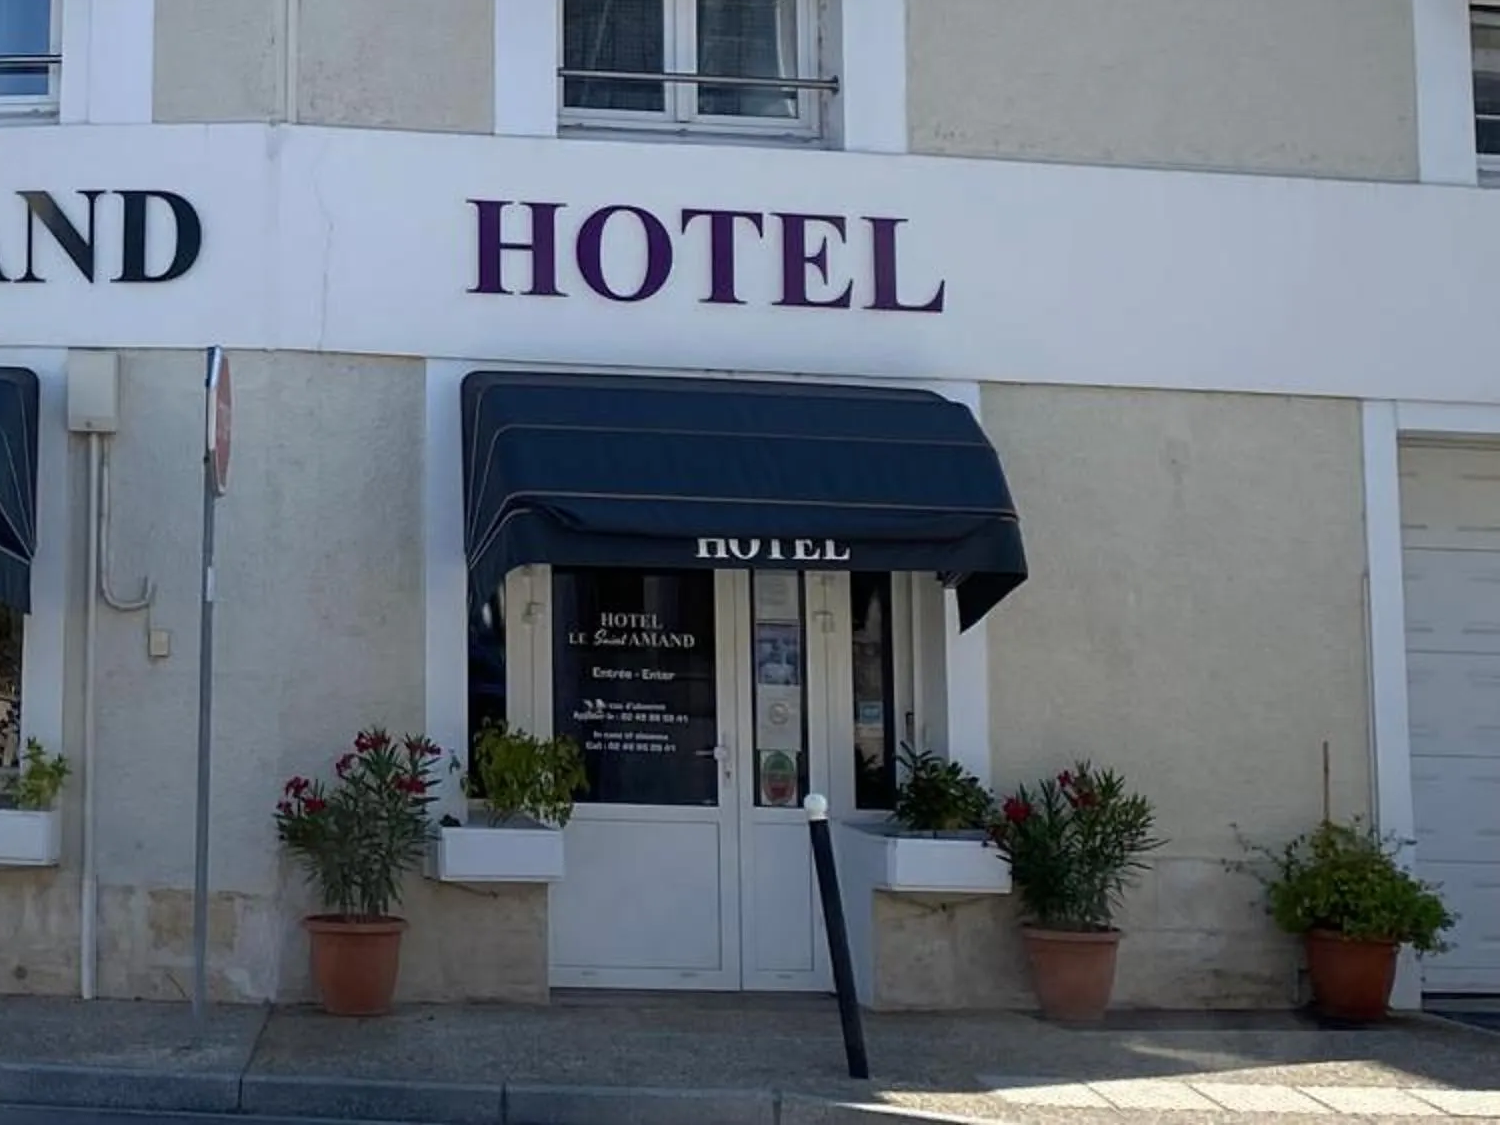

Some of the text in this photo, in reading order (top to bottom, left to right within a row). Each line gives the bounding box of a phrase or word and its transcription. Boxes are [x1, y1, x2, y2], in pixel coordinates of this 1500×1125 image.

[466, 198, 946, 313] HOTEL
[695, 538, 851, 560] HOTEL
[600, 612, 664, 630] HOTEL
[568, 628, 696, 648] LE Saint AMAND
[641, 668, 676, 680] Enter
